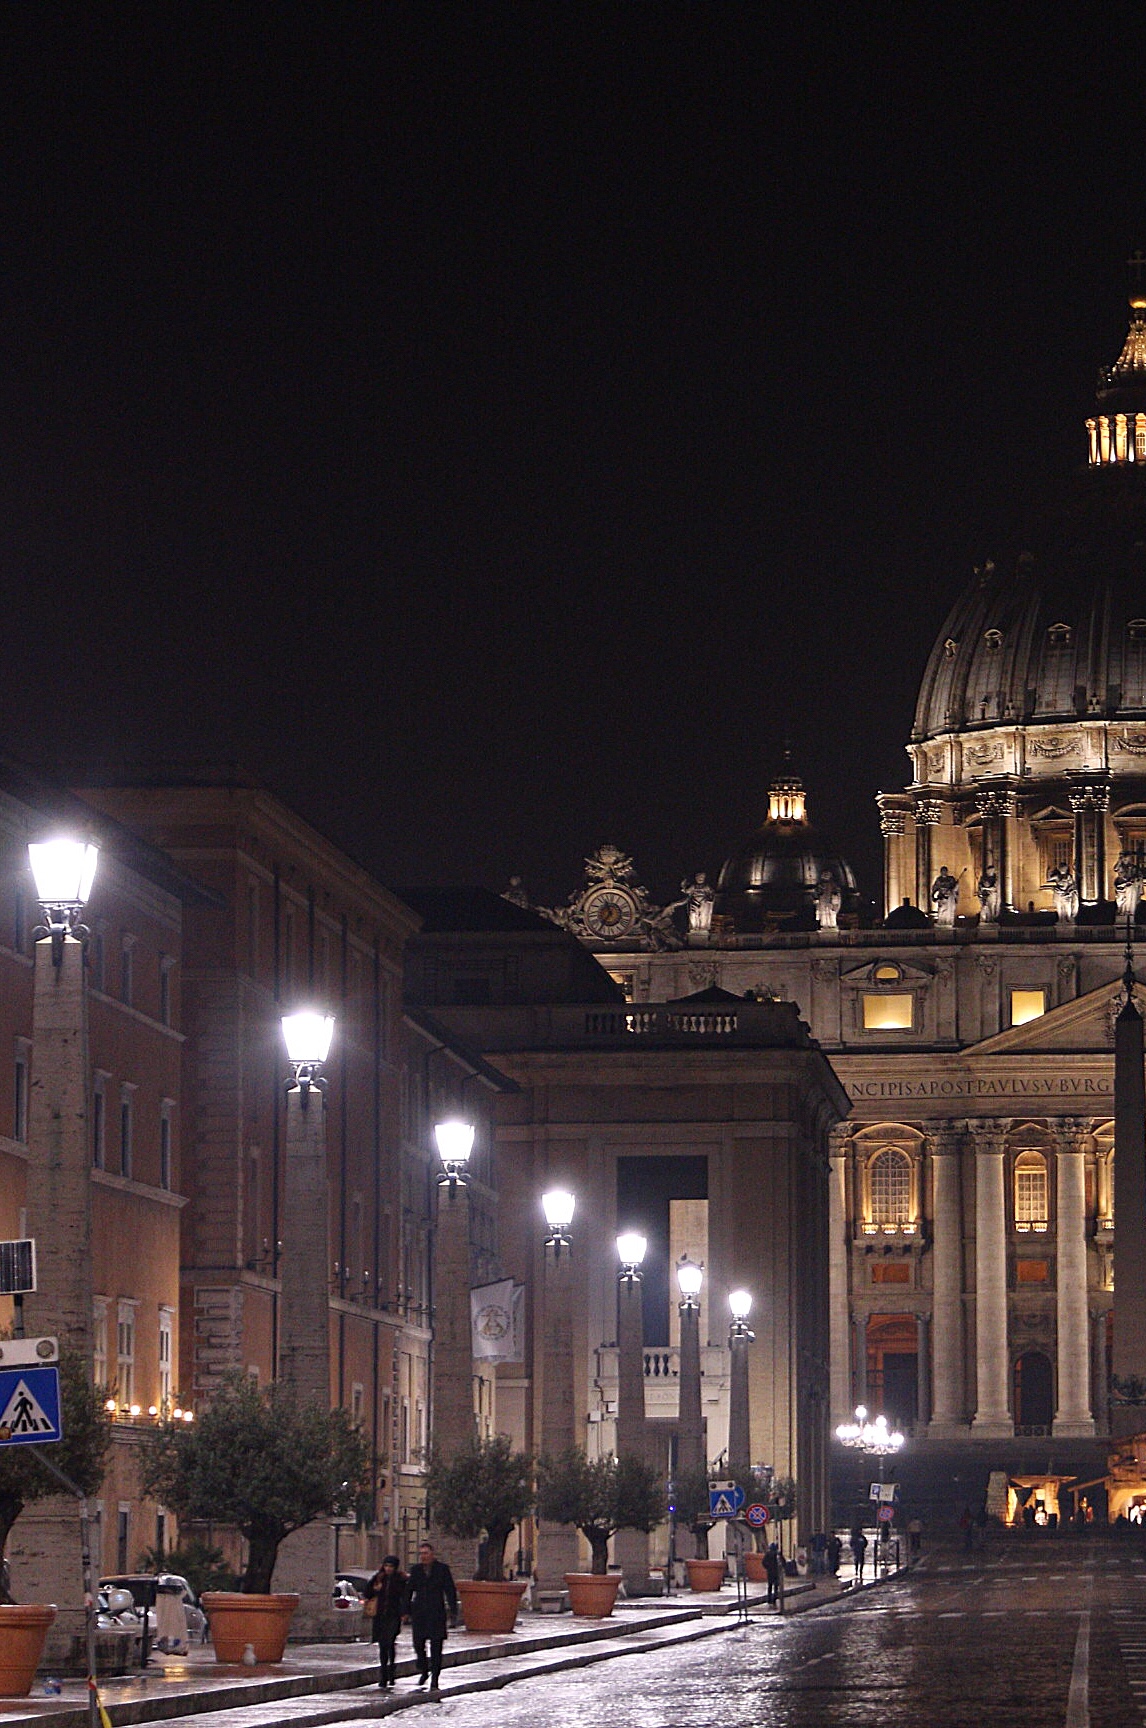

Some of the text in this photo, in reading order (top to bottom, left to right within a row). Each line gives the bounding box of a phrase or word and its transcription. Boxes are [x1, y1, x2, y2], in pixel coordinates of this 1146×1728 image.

[843, 1081, 913, 1097] NCIPIS
[917, 1080, 974, 1095] APOST
[977, 1079, 1040, 1093] PAVLVS
